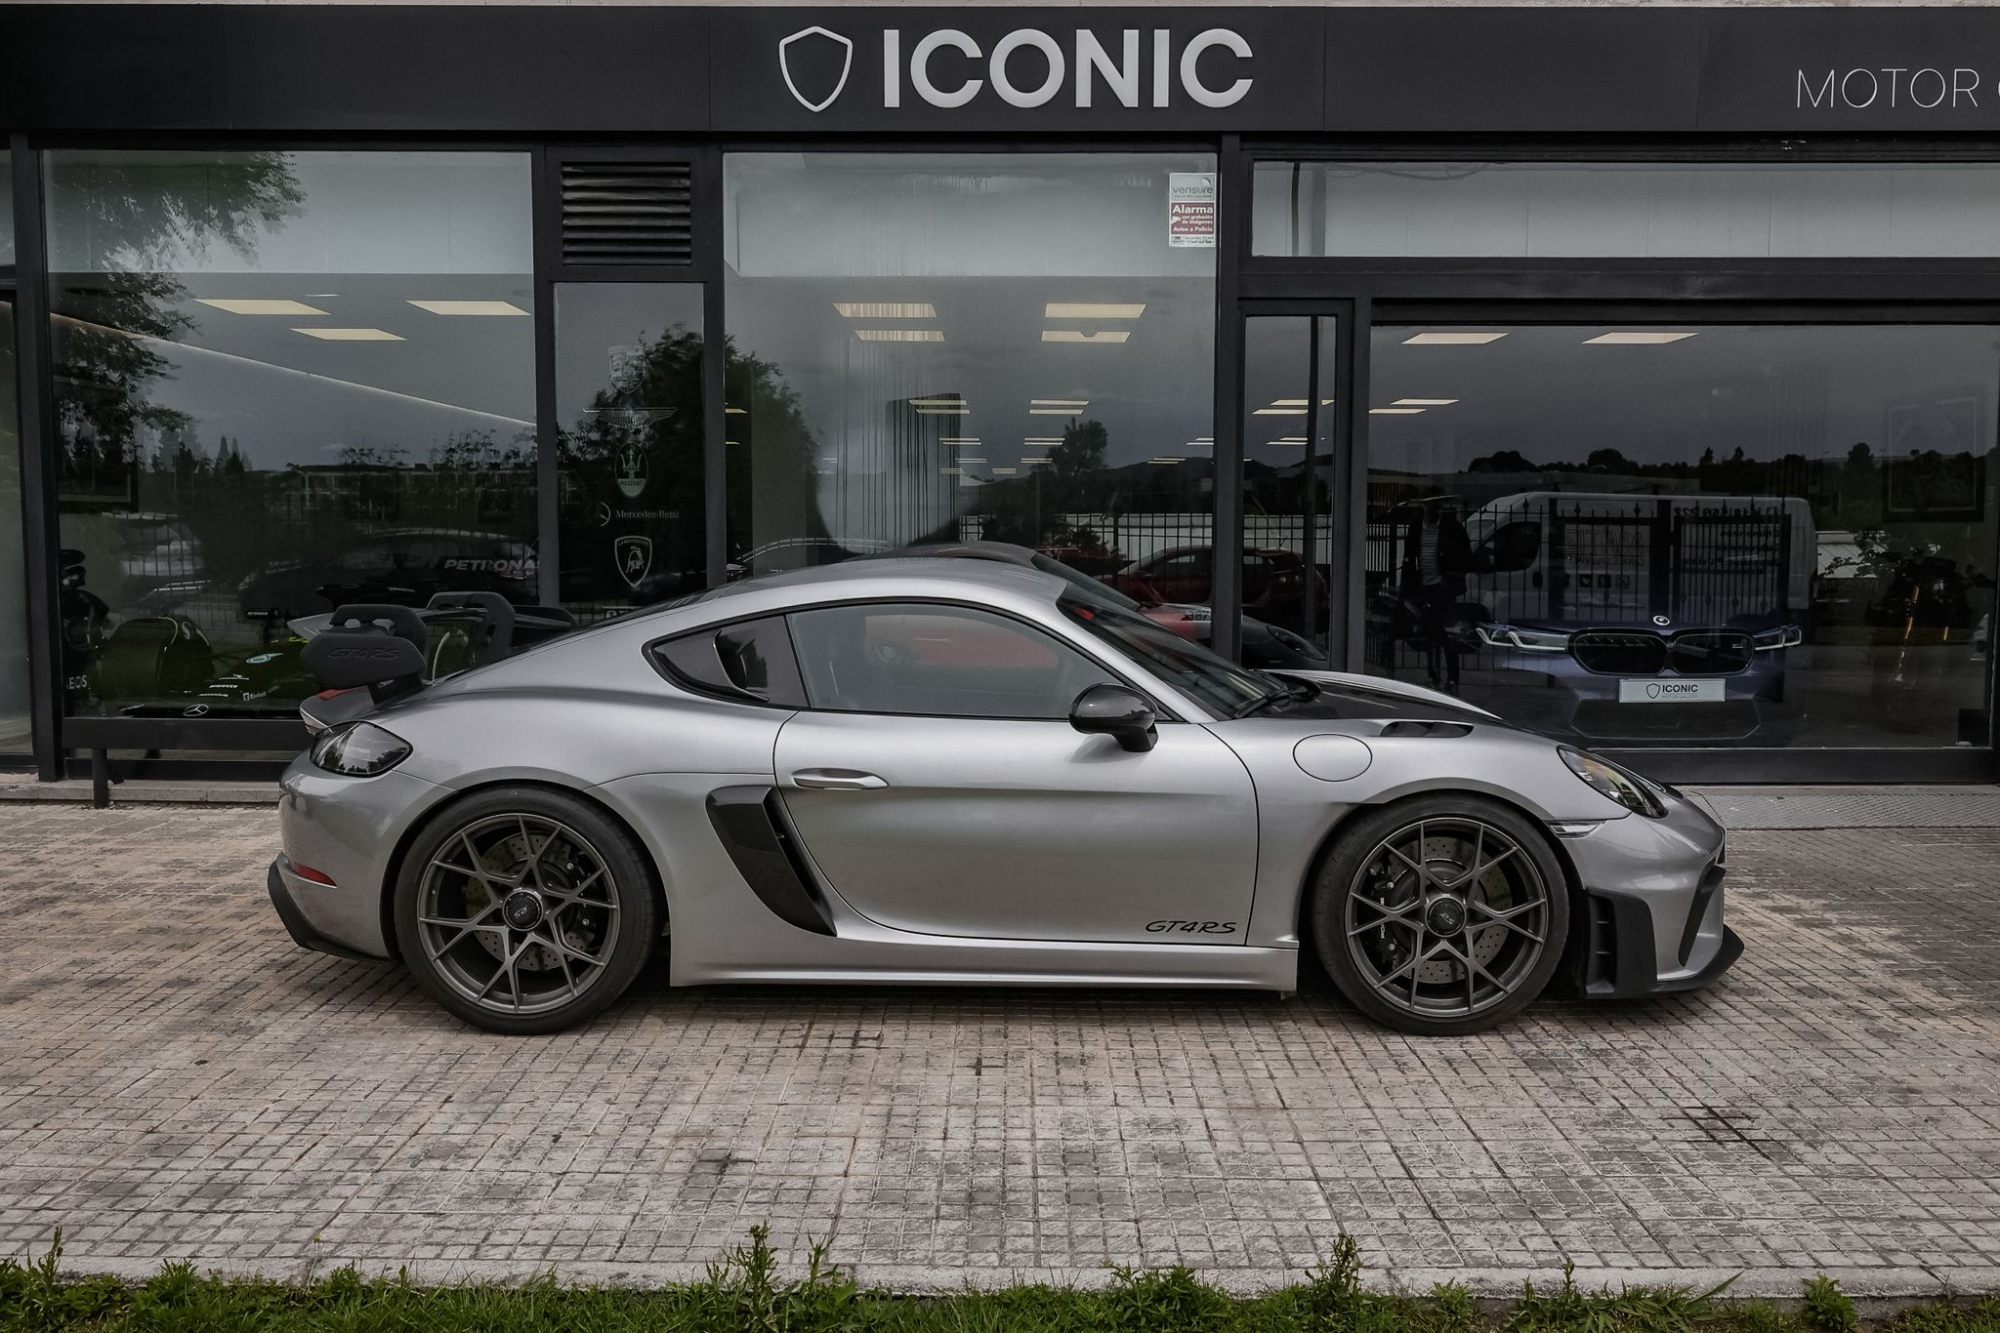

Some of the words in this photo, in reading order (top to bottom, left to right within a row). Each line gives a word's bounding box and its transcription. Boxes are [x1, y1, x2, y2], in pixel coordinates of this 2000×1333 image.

[883, 28, 1254, 108] ICONIC
[1797, 68, 1980, 108] MOTOR
[1172, 204, 1214, 214] Alarma
[616, 509, 680, 519] Mercedes-Benz
[444, 559, 539, 572] PETRONA
[66, 674, 88, 690] EOS
[1662, 684, 1699, 693] ICONIC
